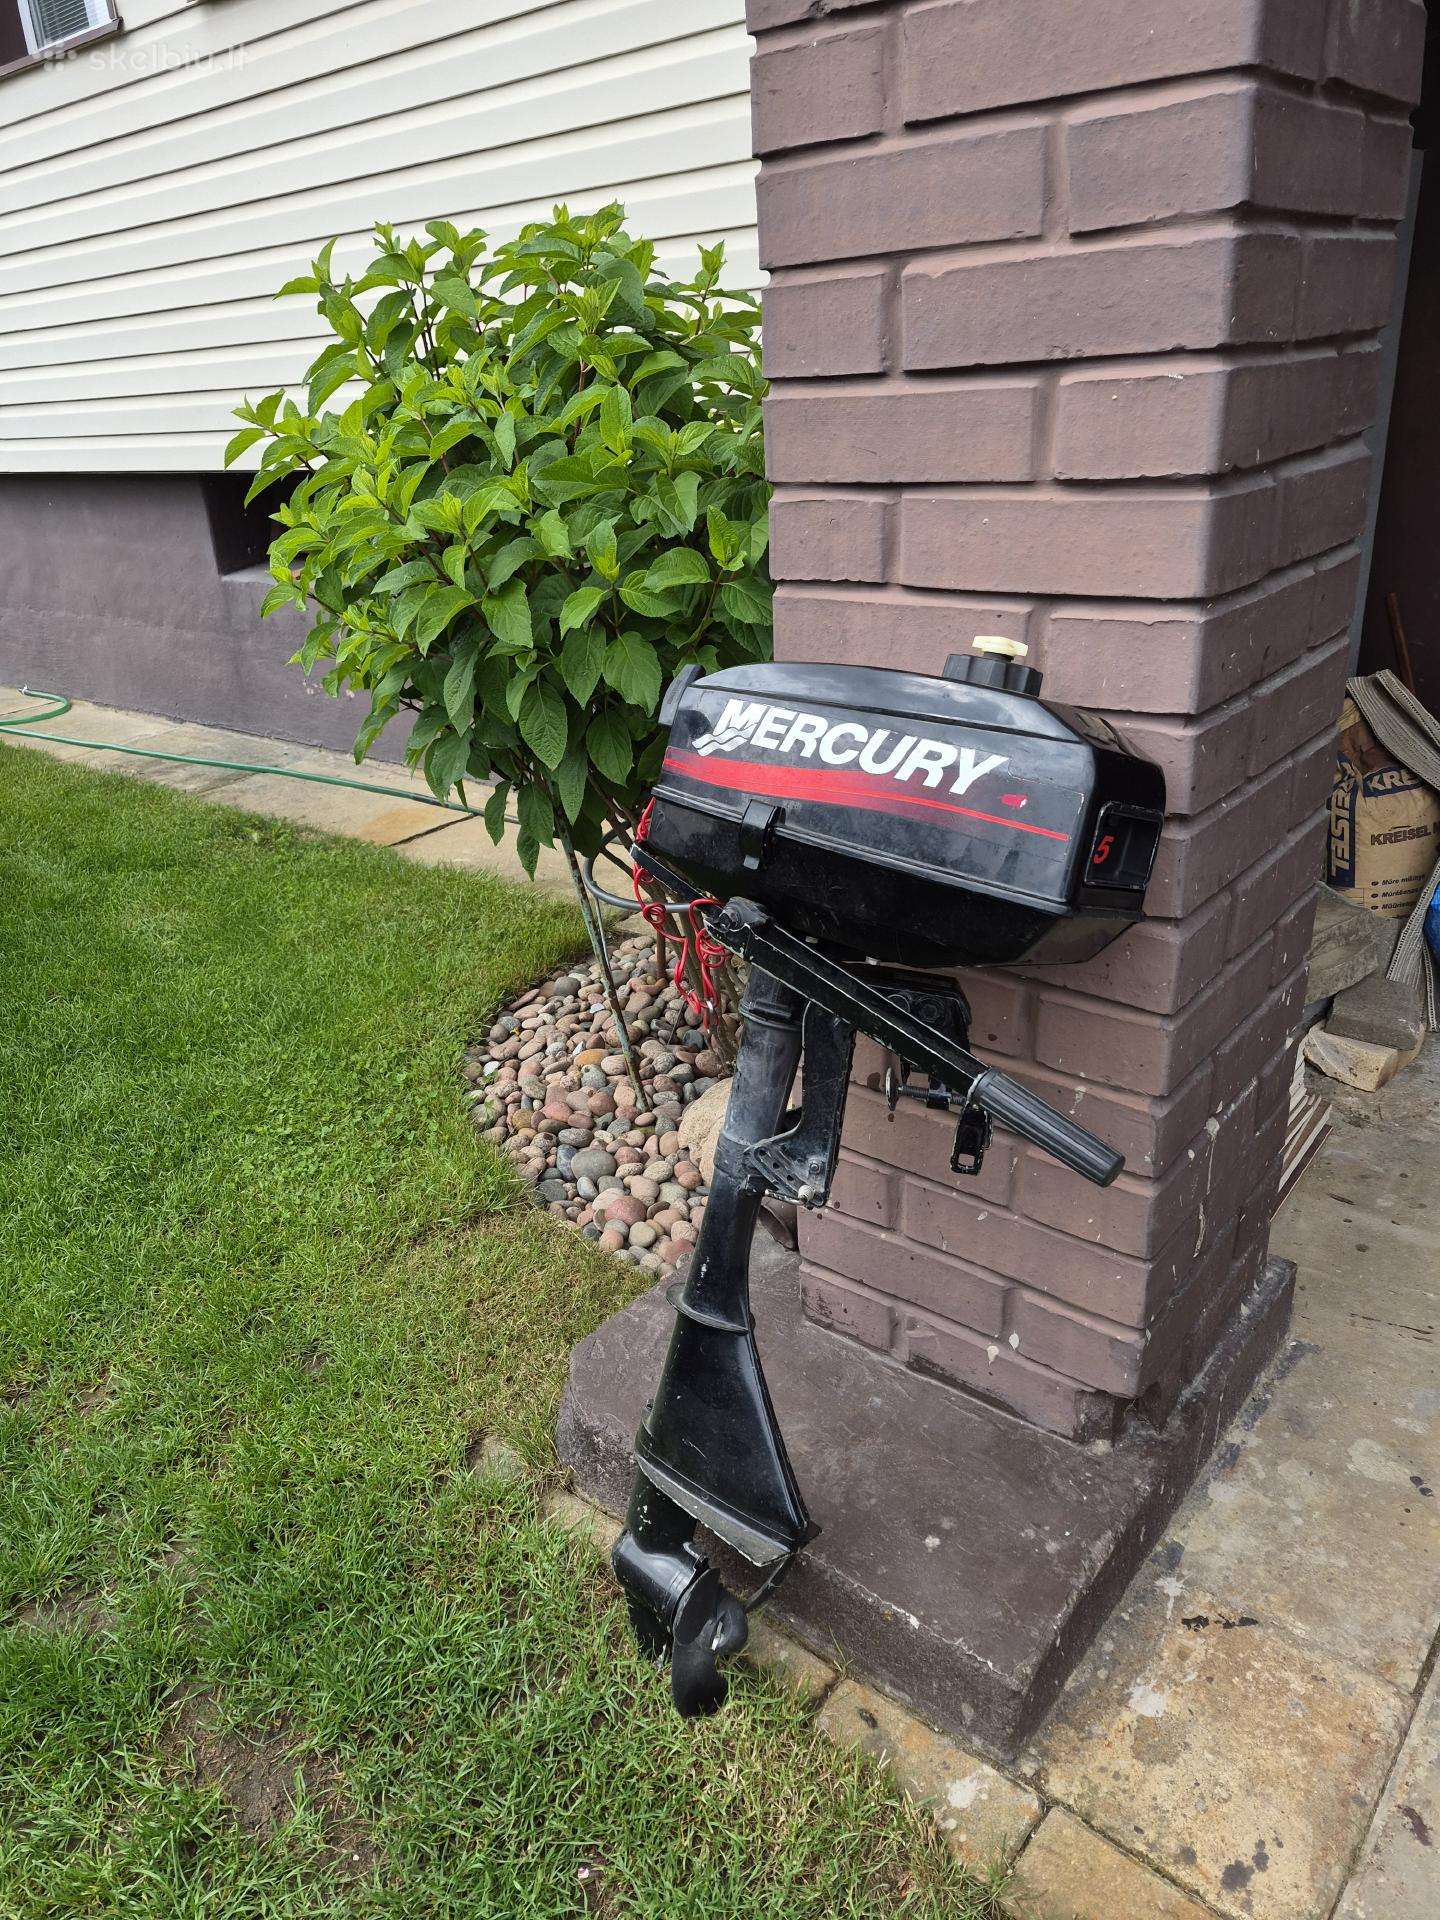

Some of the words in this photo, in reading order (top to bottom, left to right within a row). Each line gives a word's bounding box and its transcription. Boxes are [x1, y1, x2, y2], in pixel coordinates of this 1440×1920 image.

[693, 698, 1009, 796] MERCURY
[1093, 835, 1115, 864] 5
[1370, 824, 1432, 846] KREISEL
